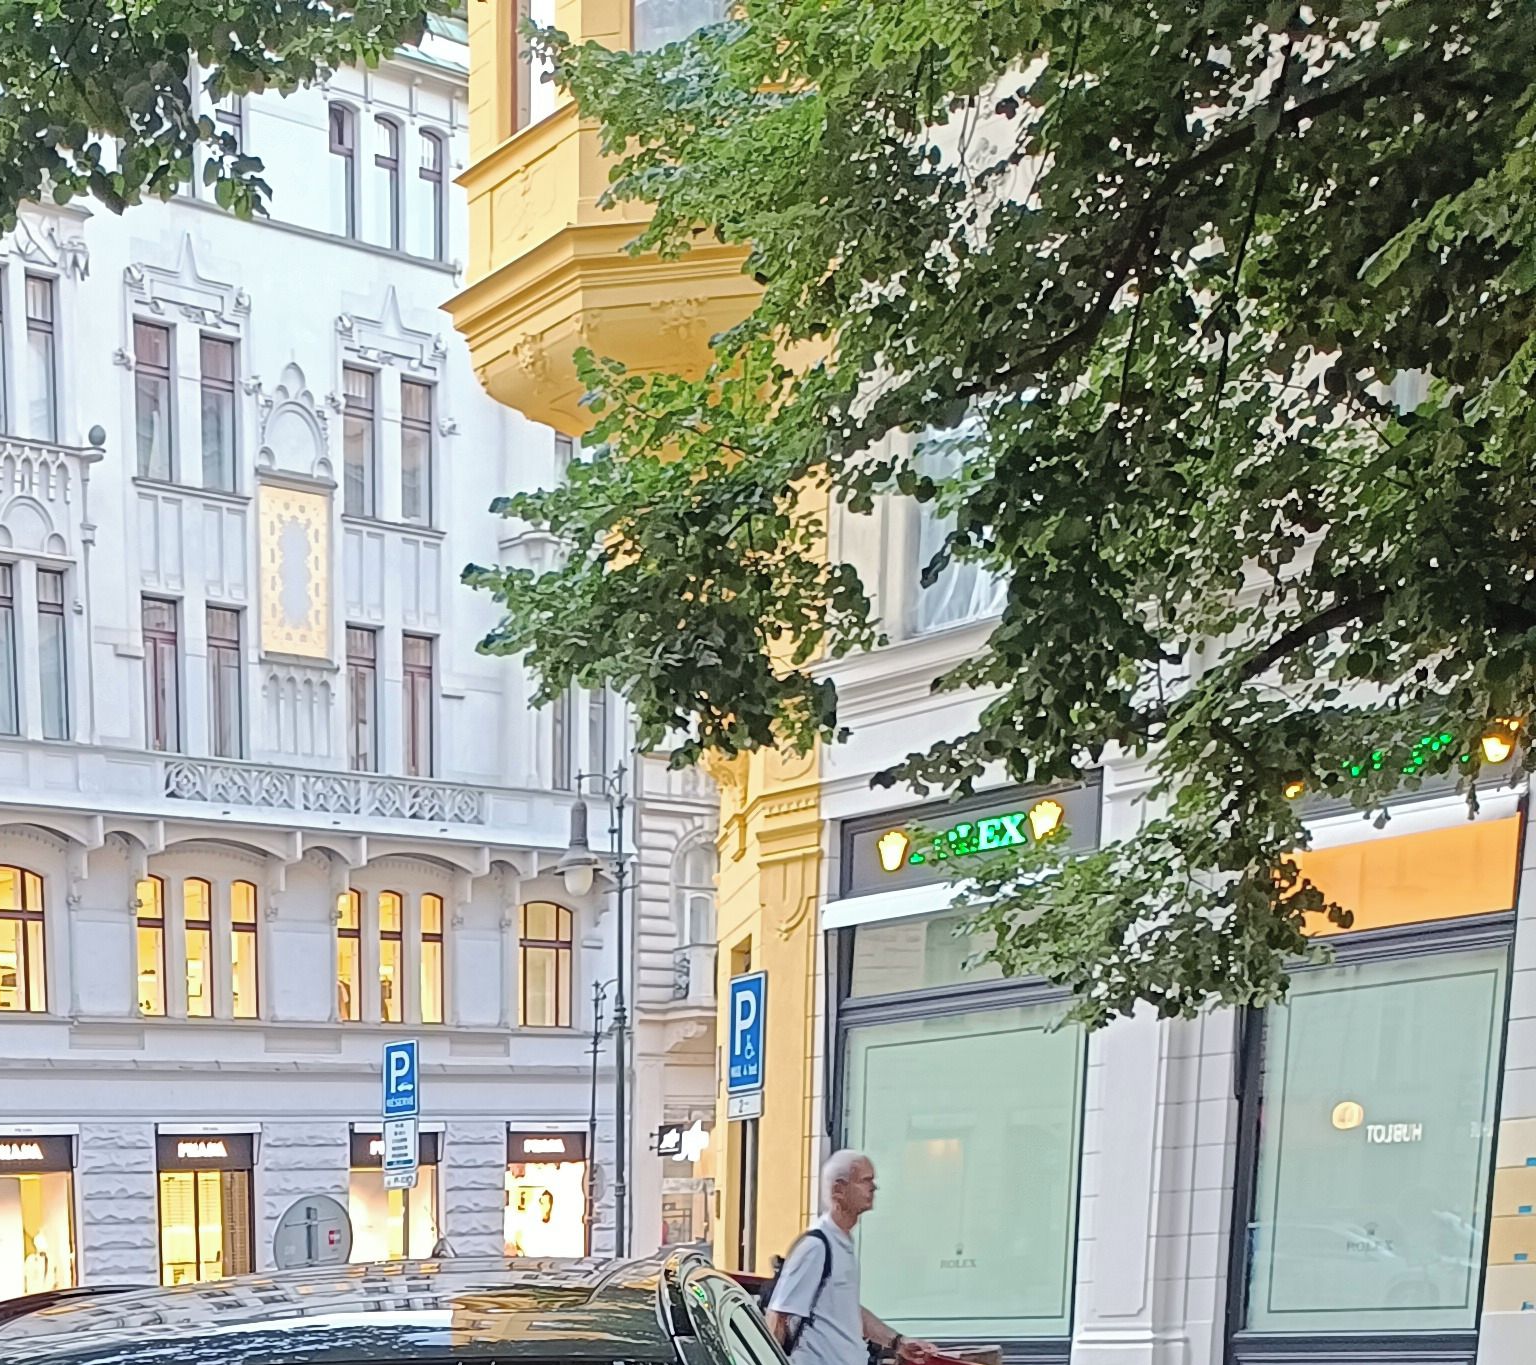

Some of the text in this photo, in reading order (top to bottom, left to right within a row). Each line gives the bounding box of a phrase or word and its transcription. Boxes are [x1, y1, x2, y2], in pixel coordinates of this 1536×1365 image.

[909, 811, 1027, 865] LEX
[735, 990, 757, 1056] P
[390, 1050, 410, 1093] P
